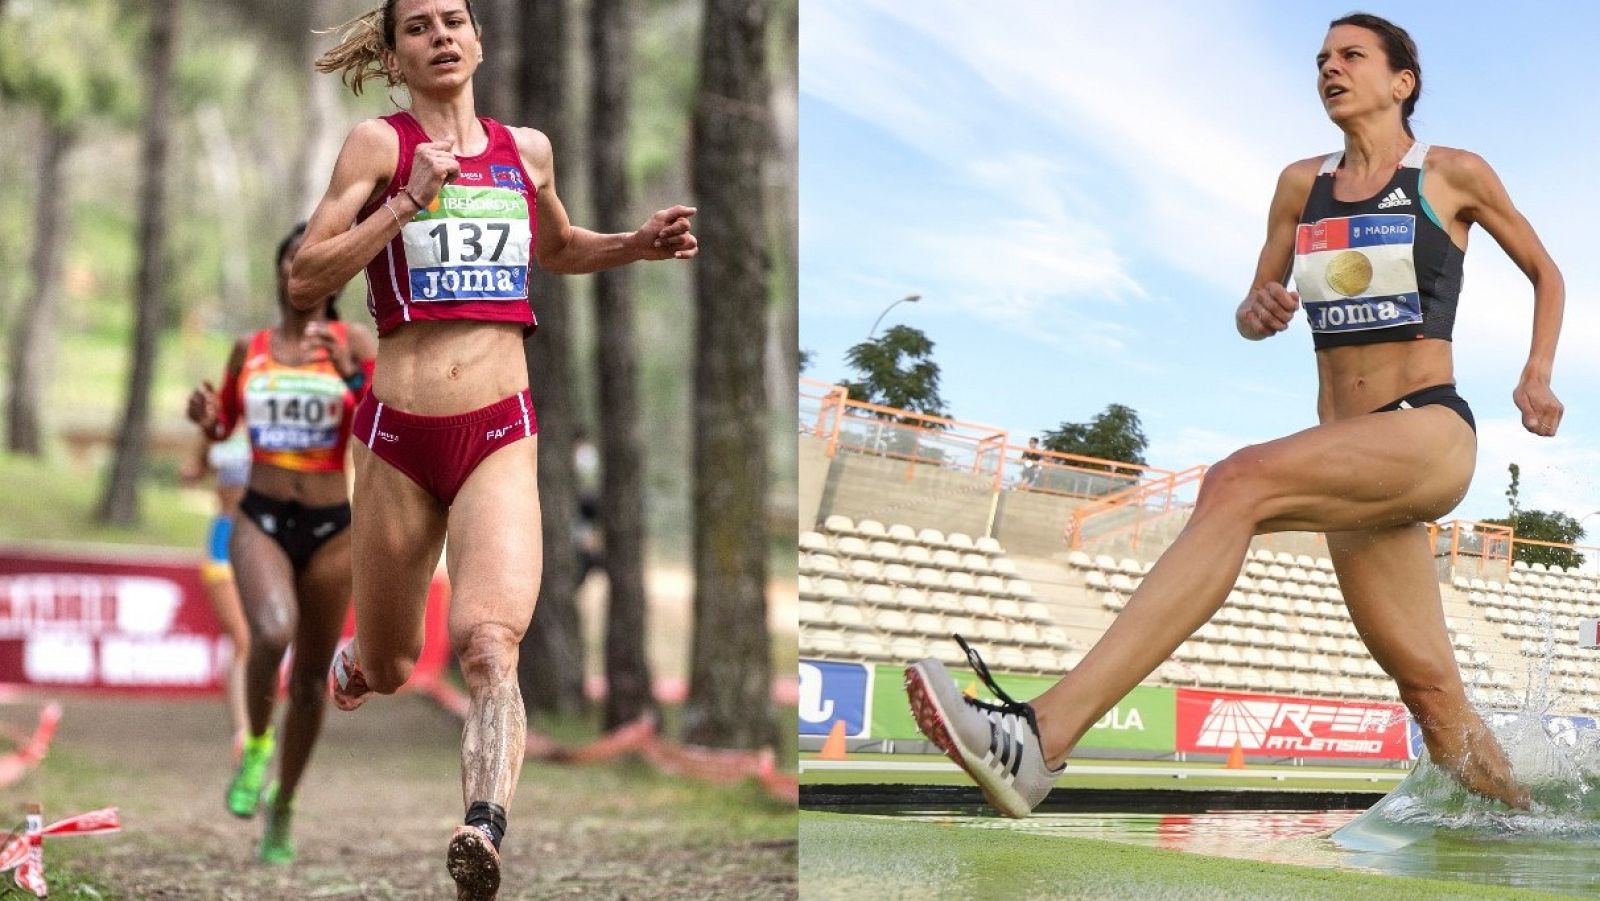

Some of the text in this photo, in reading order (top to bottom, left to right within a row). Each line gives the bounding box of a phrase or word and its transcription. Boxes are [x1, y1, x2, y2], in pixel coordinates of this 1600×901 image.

[1377, 199, 1412, 210] adidas
[1365, 225, 1408, 235] MADRID
[428, 222, 511, 263] 137
[267, 398, 324, 425] 140
[1273, 704, 1391, 737] RFEA
[1267, 737, 1382, 753] ATLETISMO
